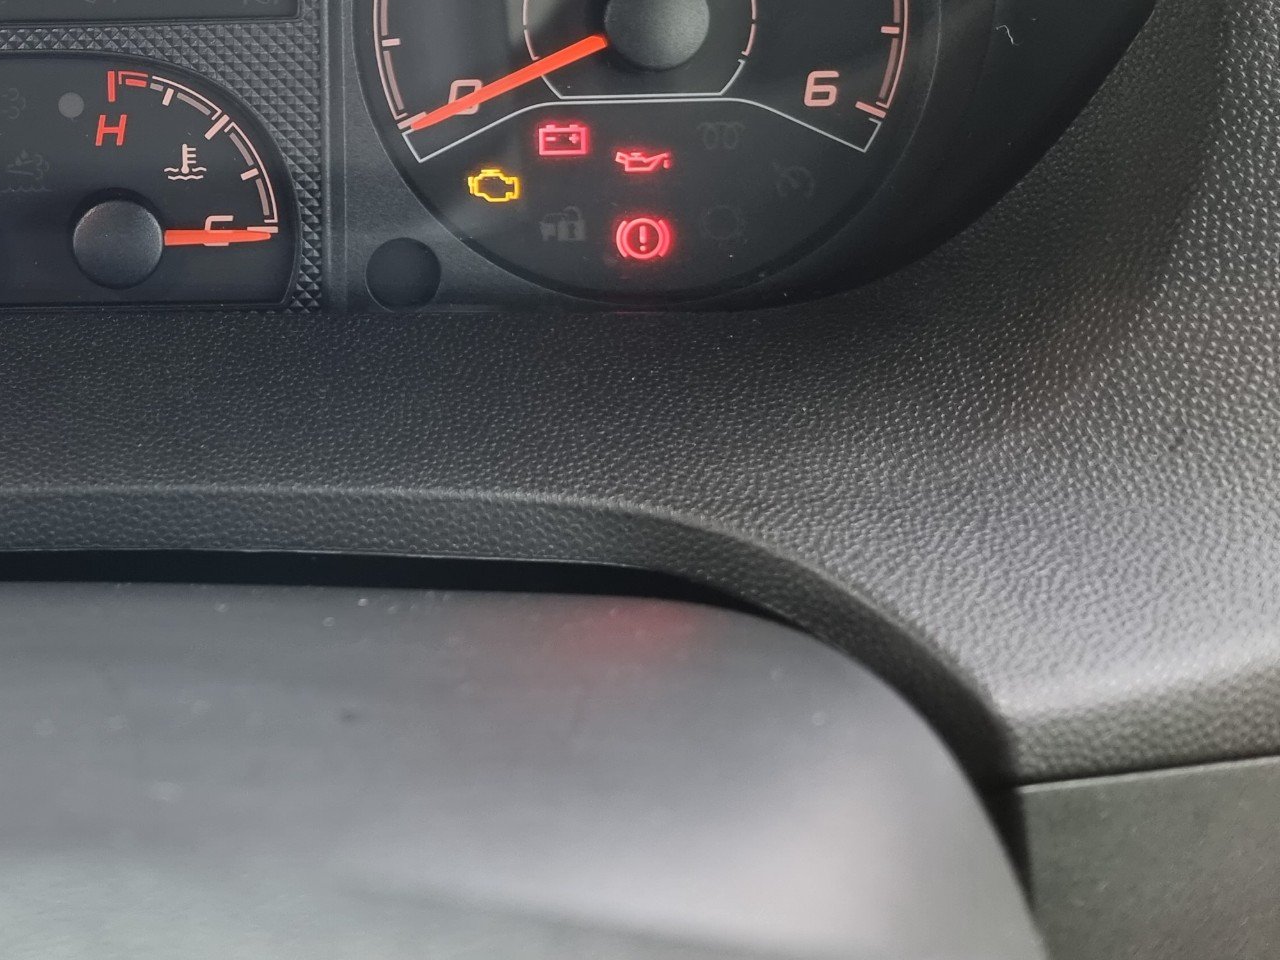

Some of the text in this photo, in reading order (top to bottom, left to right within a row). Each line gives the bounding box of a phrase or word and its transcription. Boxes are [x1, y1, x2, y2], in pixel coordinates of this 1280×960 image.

[448, 80, 482, 115] 0
[803, 71, 840, 106] 6
[95, 115, 127, 146] H
